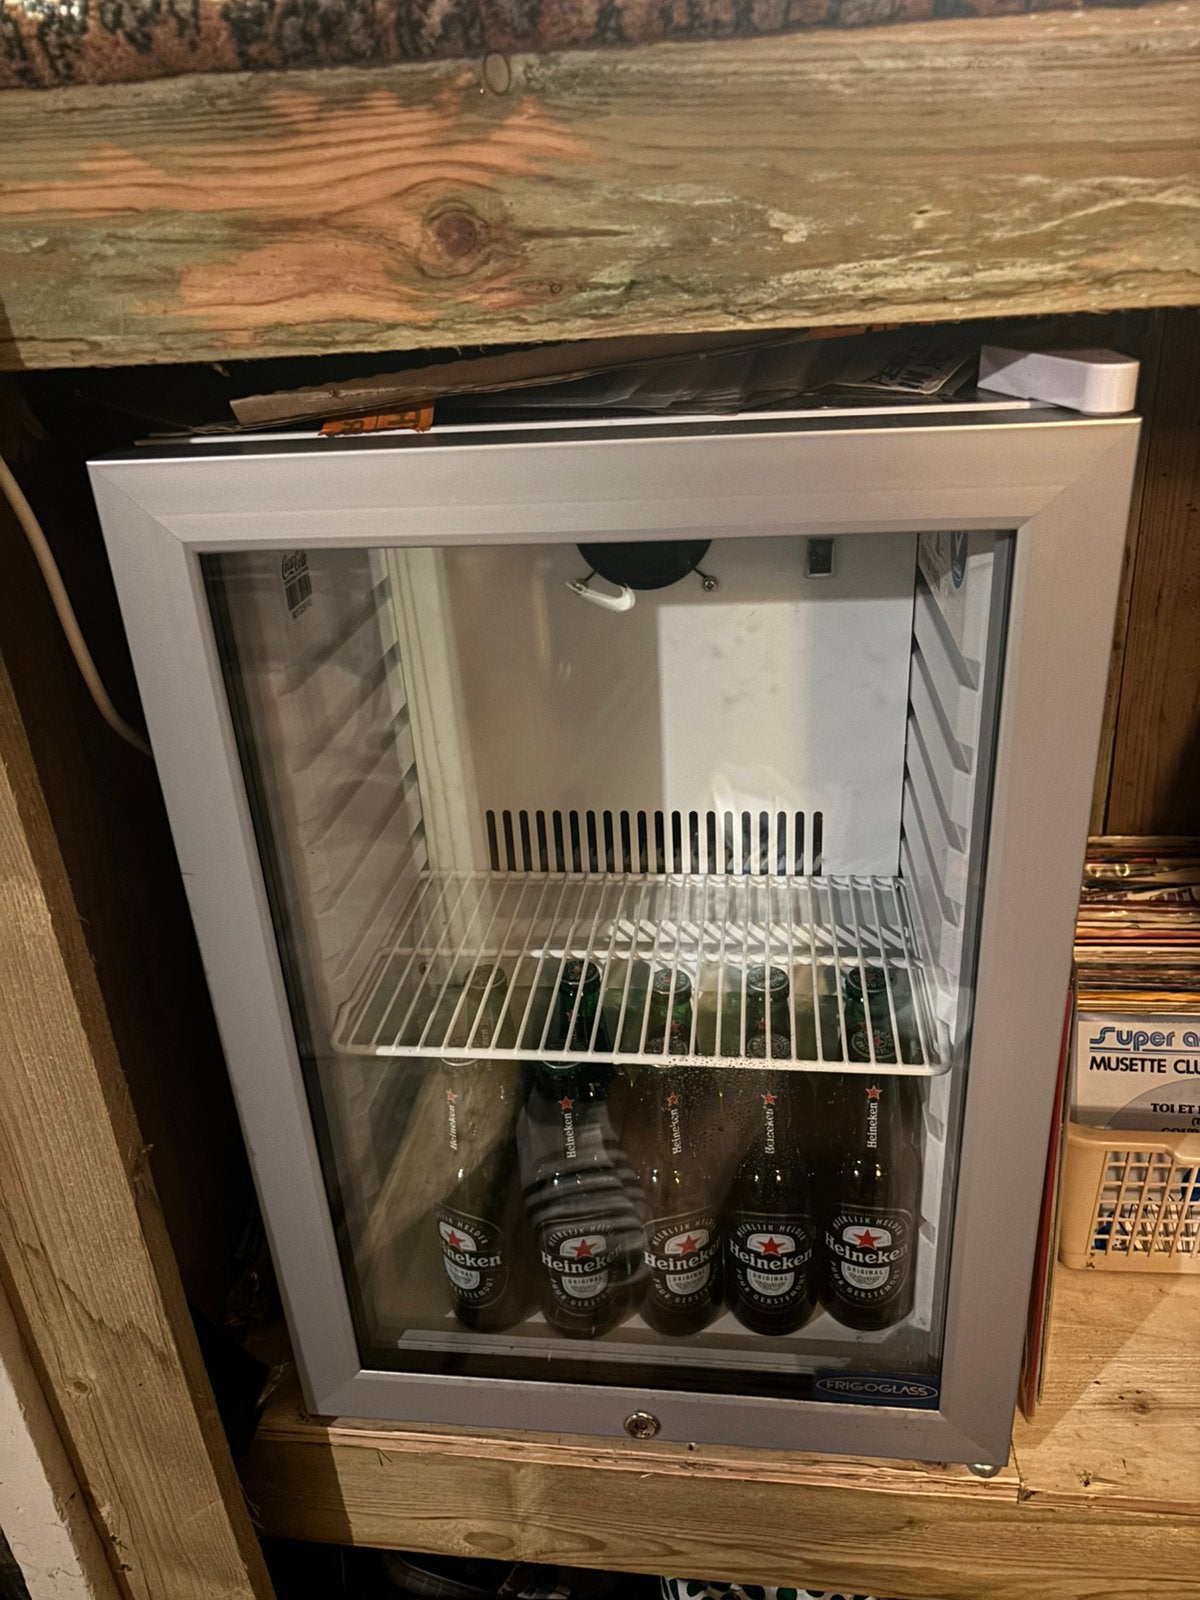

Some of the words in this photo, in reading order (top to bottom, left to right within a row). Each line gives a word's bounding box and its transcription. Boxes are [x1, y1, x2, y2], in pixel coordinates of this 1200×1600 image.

[1089, 1026, 1176, 1051] Super
[1182, 1031, 1200, 1048] a
[1089, 1056, 1167, 1074] MUSETTE
[1150, 1102, 1175, 1114] TOI
[1178, 1104, 1195, 1115] ET
[448, 1105, 458, 1151] Heineken
[563, 1112, 577, 1159] Heineken
[669, 1108, 683, 1155] Heineken
[764, 1108, 776, 1154] Heineken
[866, 1102, 878, 1149] Heineken
[540, 1243, 623, 1274] Heineken
[729, 1238, 813, 1270] Heineken
[825, 1230, 909, 1265] Heineken
[753, 1271, 790, 1282] ORIGINAL
[847, 1264, 884, 1277] ORIGINAL
[826, 1380, 928, 1397] FRIGOGLASS
